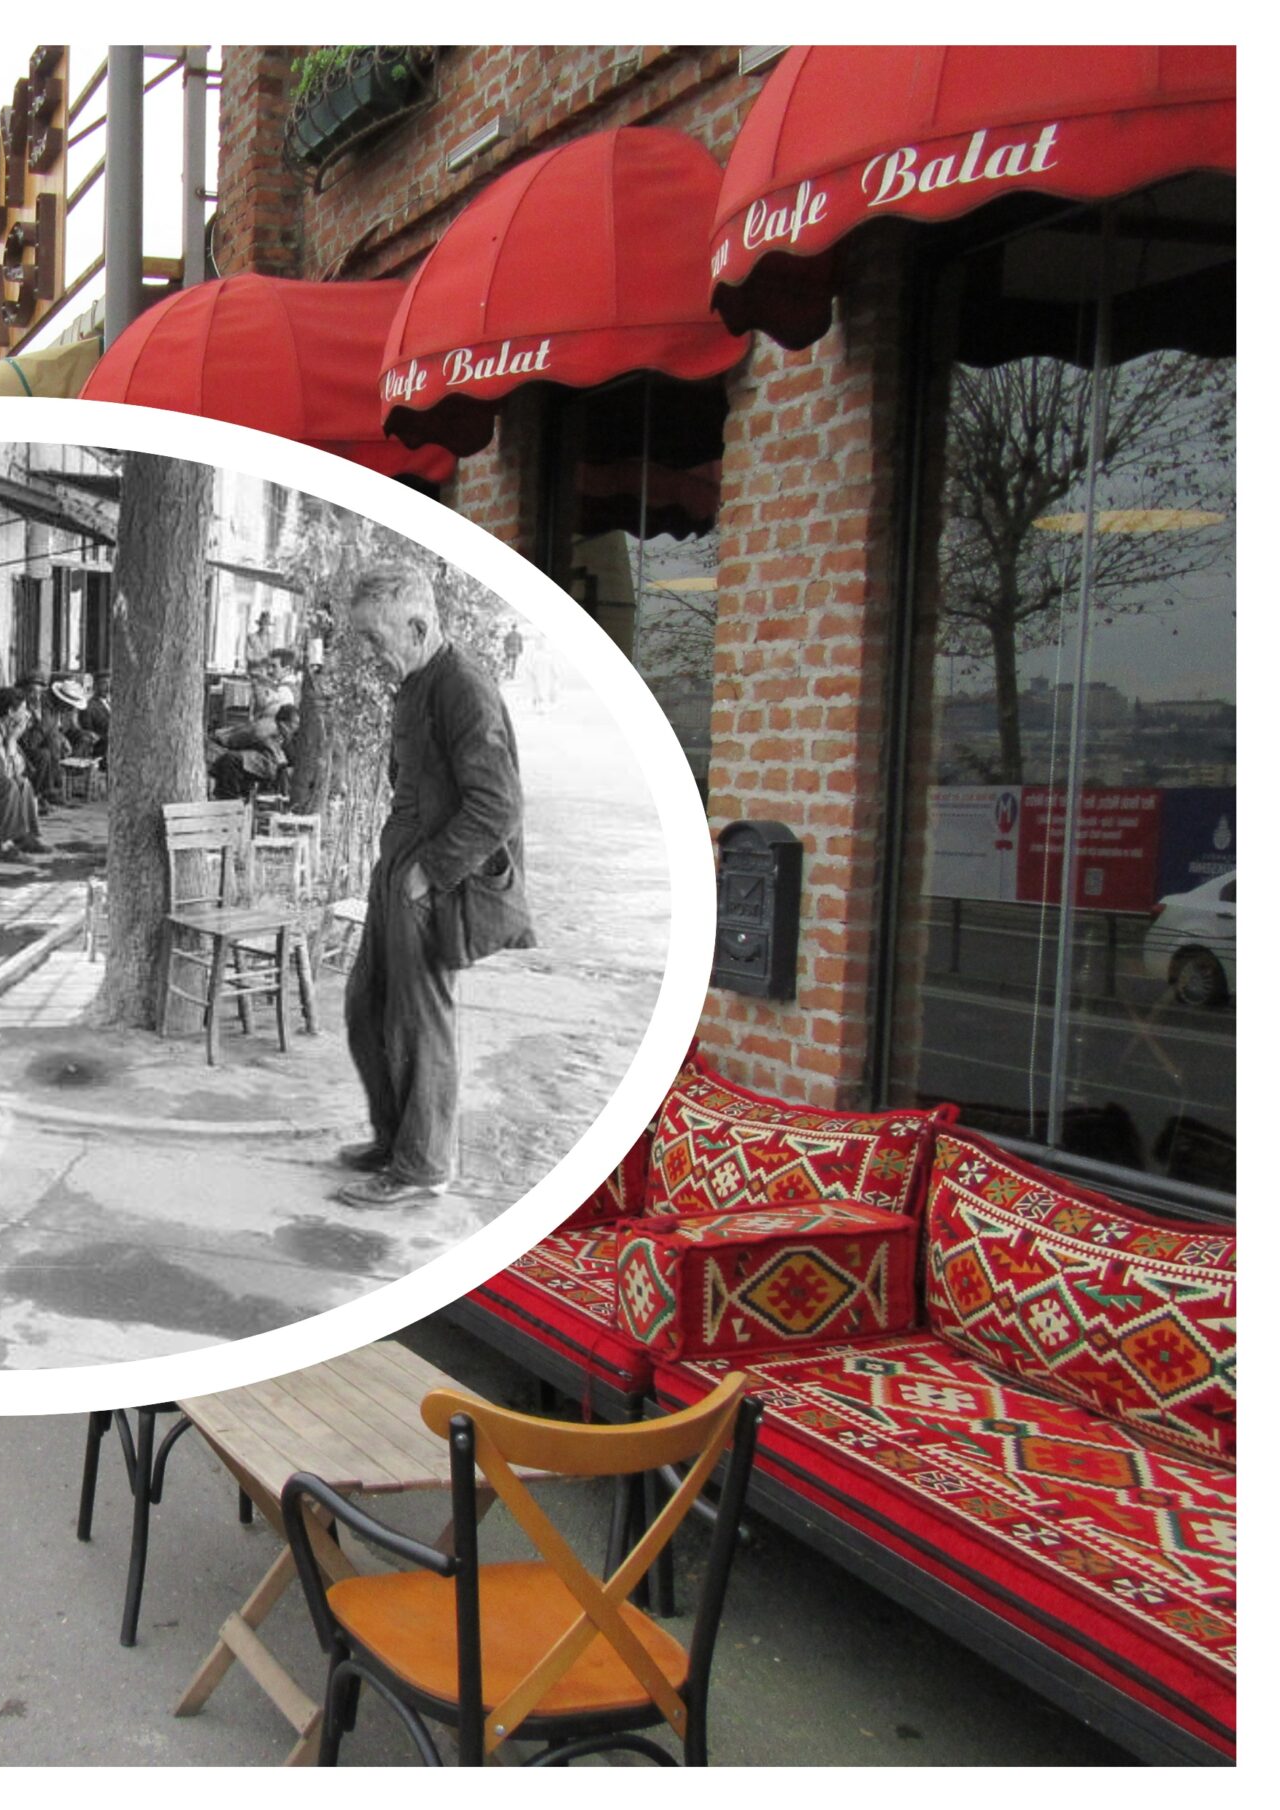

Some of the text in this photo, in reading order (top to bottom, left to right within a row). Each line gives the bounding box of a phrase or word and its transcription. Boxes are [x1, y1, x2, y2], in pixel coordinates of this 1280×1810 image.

[743, 179, 828, 250] Cafe
[861, 123, 1059, 207] Balat
[384, 339, 551, 402] Cafe Balat
